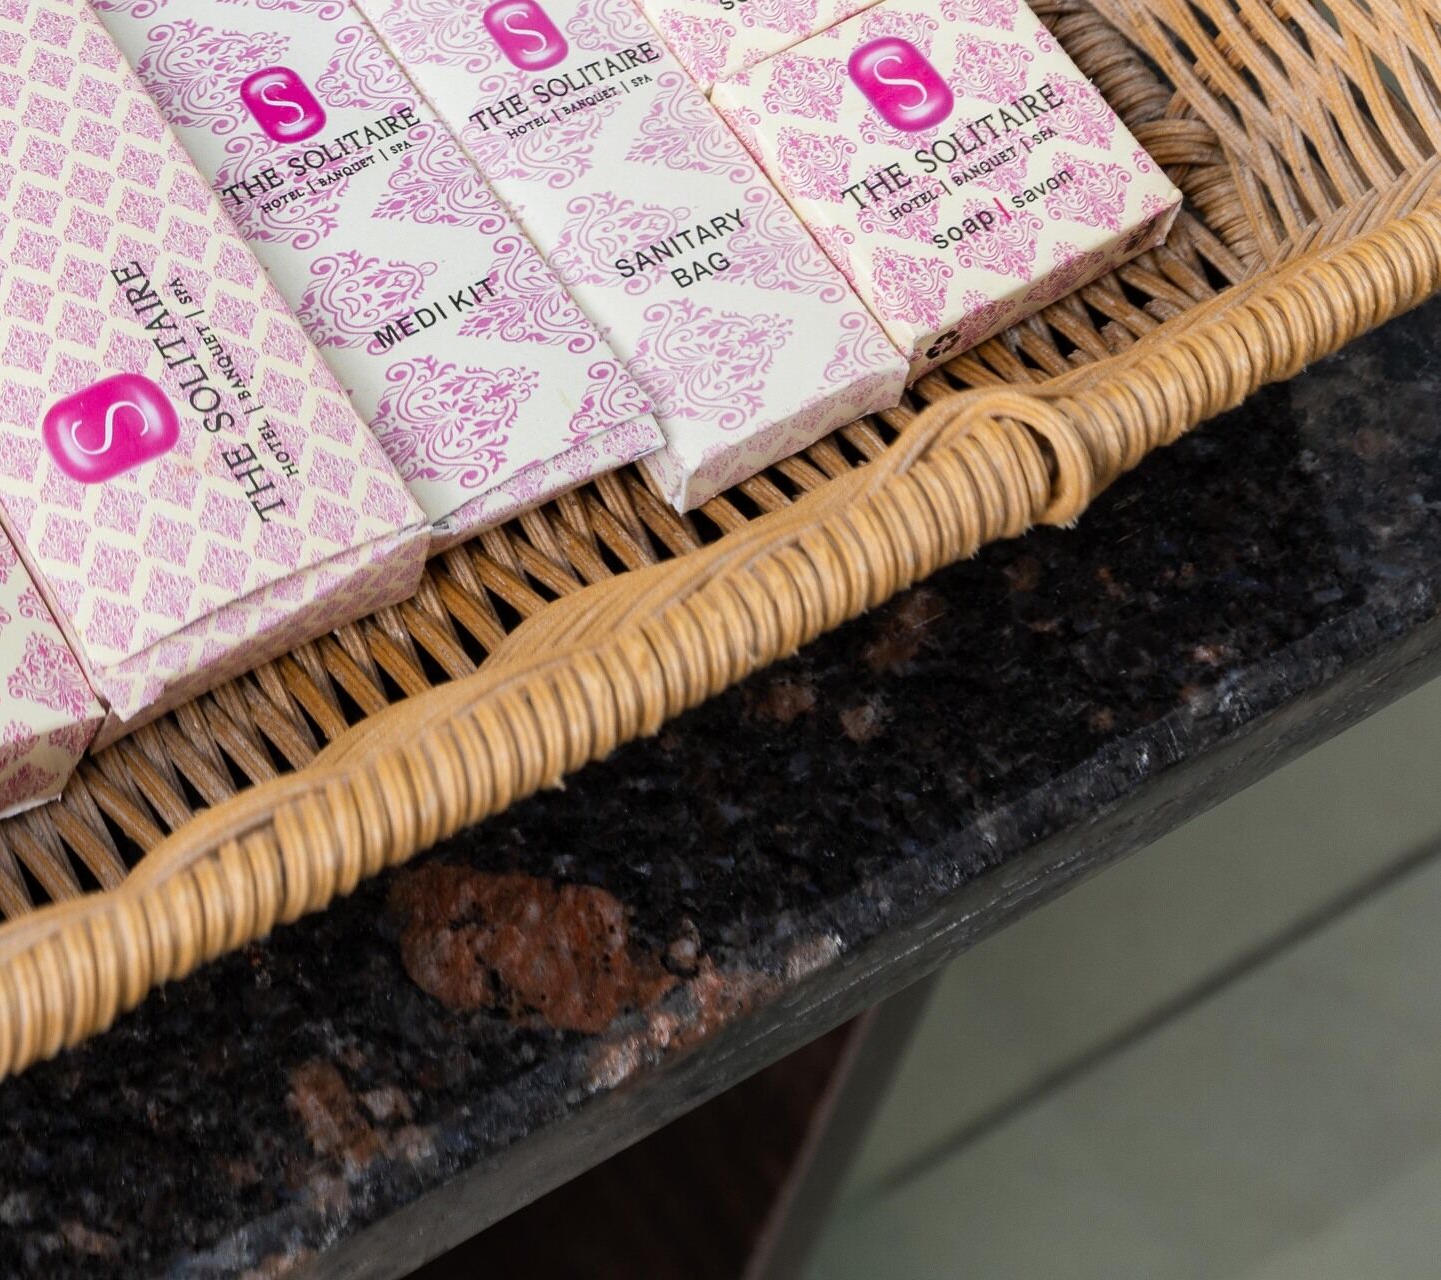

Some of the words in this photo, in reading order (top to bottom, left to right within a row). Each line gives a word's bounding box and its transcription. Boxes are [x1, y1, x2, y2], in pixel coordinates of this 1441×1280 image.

[469, 94, 529, 132] THE
[533, 41, 660, 104] SOLITAIRE
[507, 118, 550, 140] HOTEL
[562, 86, 617, 115] BANQUET
[630, 74, 653, 88] SPA
[222, 167, 284, 206] THE
[288, 106, 420, 177] SOLITAIRE
[261, 188, 306, 213] HOTEL
[318, 154, 376, 187] BANQUET
[390, 141, 412, 155] SPA
[841, 162, 912, 210] THE
[915, 83, 1064, 174] SOLITAIRE
[889, 189, 939, 220] HOTEL
[951, 145, 1017, 187] BANQUET
[1035, 127, 1058, 145] SPA
[615, 208, 746, 279] SANITARY
[933, 209, 994, 249] soap
[1011, 169, 1073, 209] savon
[169, 277, 192, 305] SPA
[670, 251, 731, 289] BAG
[111, 261, 235, 433] SOLITAIRE
[373, 301, 448, 348] MEDI
[448, 277, 498, 312] KIT
[196, 326, 252, 401] BANQUET
[222, 443, 286, 523] THE
[257, 420, 299, 478] HOTEL
